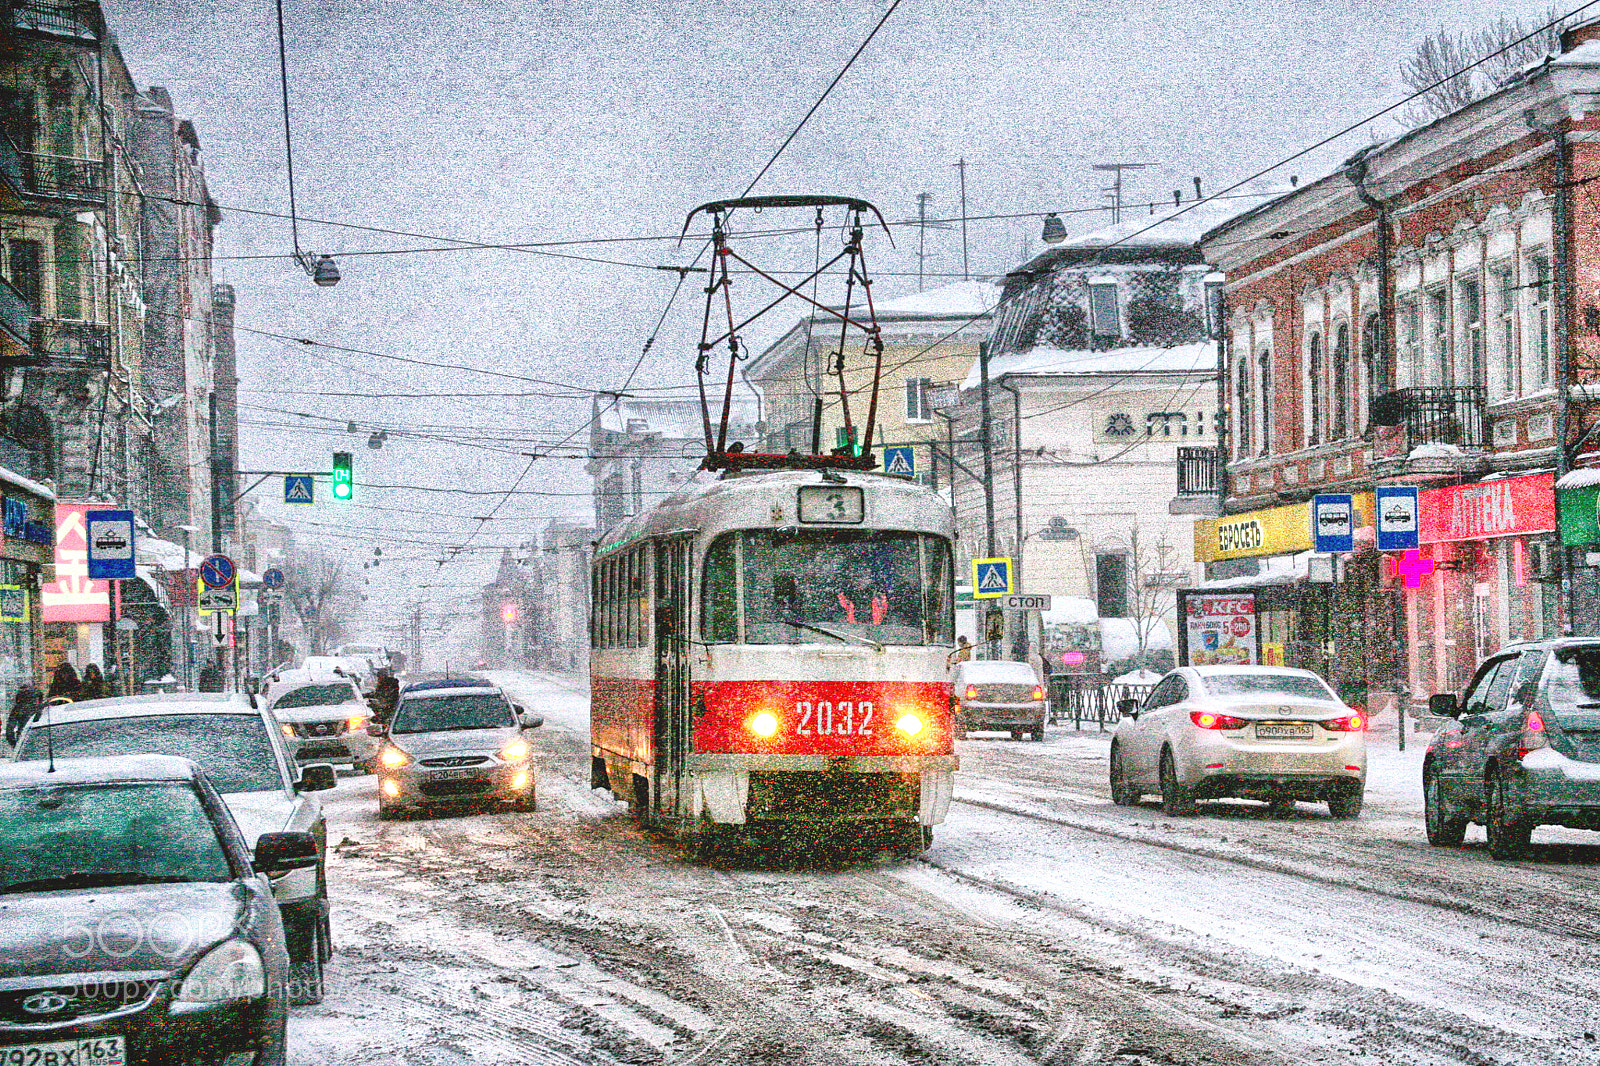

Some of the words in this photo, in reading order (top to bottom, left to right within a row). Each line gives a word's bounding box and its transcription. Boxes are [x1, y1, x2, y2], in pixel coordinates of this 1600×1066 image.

[335, 469, 349, 481] 04
[826, 494, 846, 519] 3
[1453, 482, 1515, 536] АПТЕКА
[1219, 520, 1261, 551] ЕВРОСЕТЬ
[1008, 597, 1044, 608] СТОП
[1211, 601, 1249, 613] KFC
[1222, 621, 1229, 635] 5
[797, 701, 873, 735] 2032
[81, 1040, 119, 1059] 163
